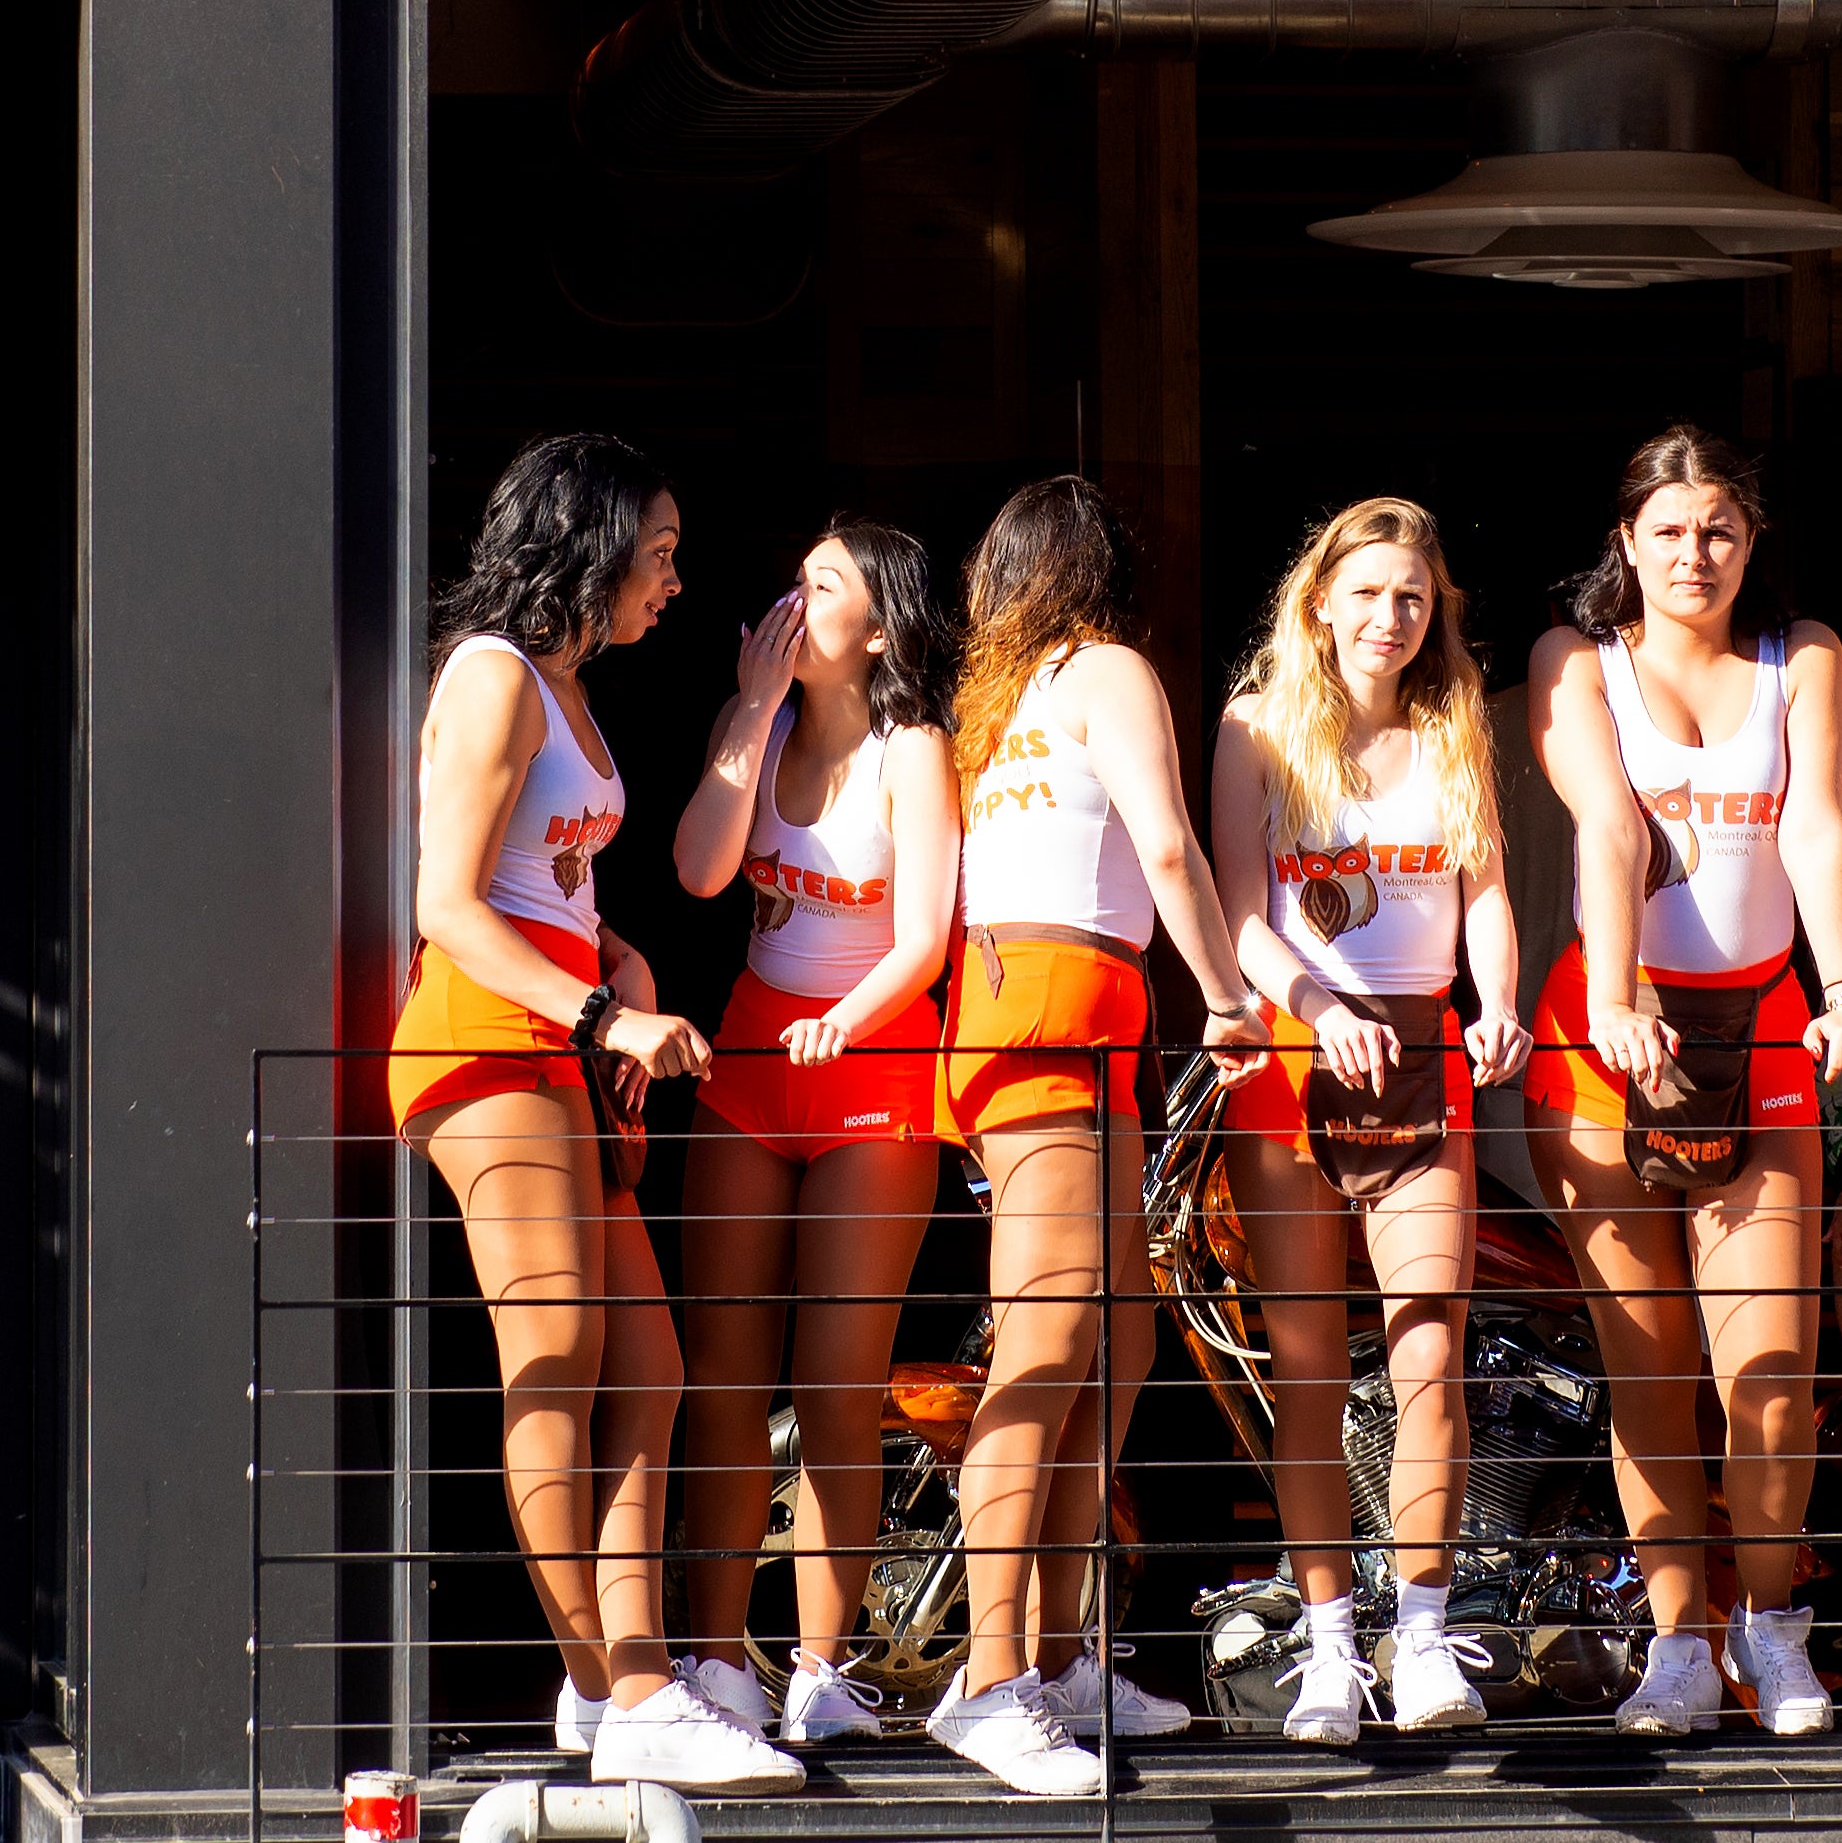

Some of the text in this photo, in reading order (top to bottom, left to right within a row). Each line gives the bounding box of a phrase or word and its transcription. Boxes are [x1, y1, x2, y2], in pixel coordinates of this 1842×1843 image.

[966, 781, 1057, 833] PPY!
[1274, 843, 1453, 884] HOOTER
[1383, 876, 1434, 888] Montreal,
[1383, 892, 1423, 902] CANADA
[797, 904, 838, 920] CANADA
[1761, 1091, 1804, 1111] HOOTERS
[844, 1111, 890, 1128] HOOTERS
[1646, 1129, 1732, 1162] HOOTERS
